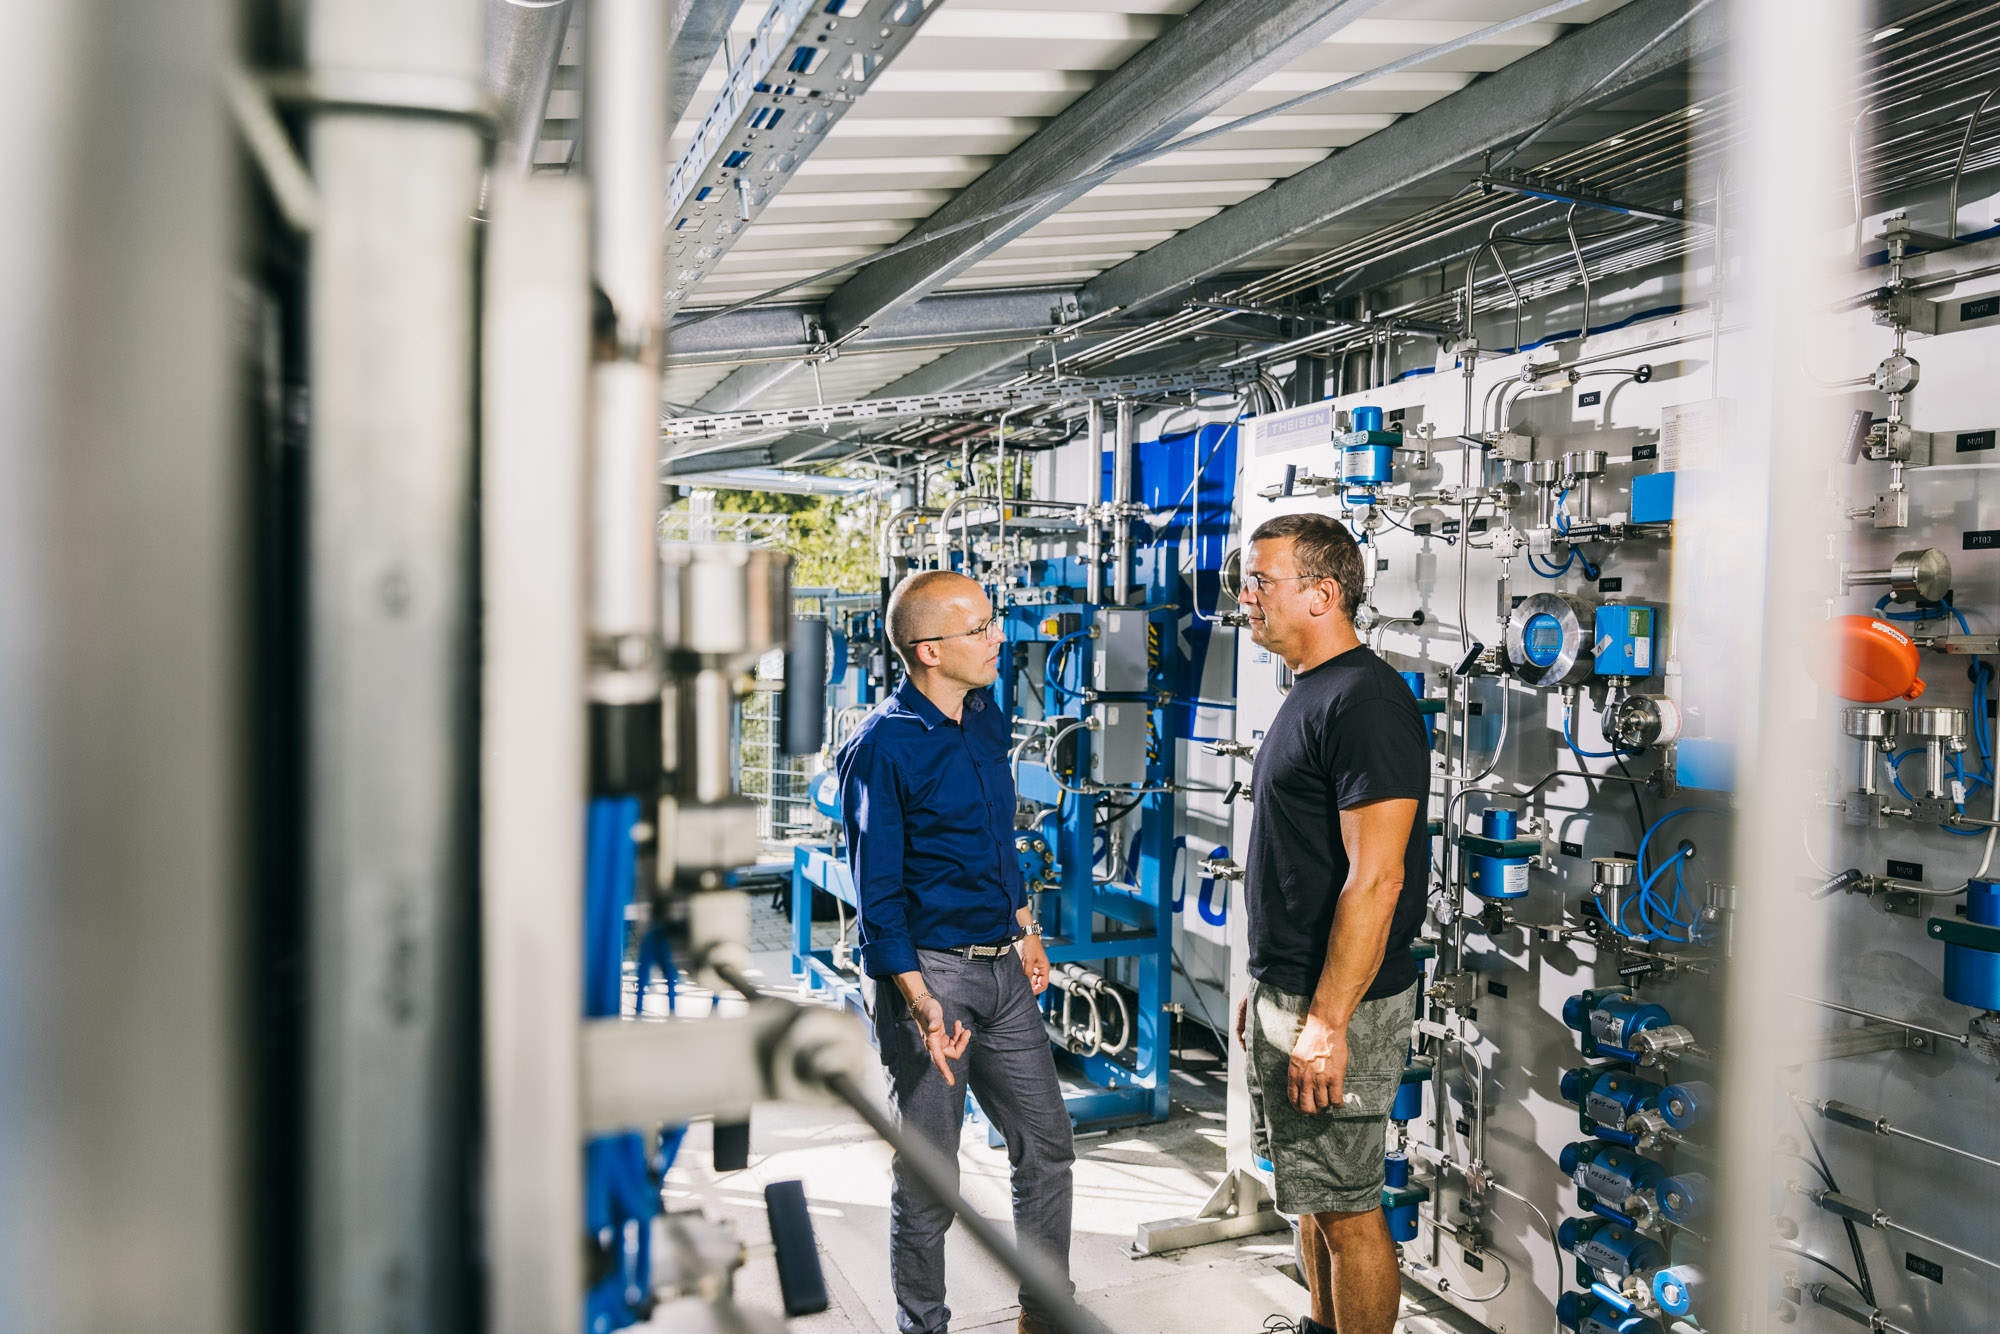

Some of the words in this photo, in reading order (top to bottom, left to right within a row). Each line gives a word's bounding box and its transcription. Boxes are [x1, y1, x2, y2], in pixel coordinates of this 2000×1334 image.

[1970, 303, 1989, 314] MV12
[1271, 414, 1325, 434] THEISEN
[1967, 436, 1984, 445] MV11
[1620, 964, 1651, 974] MAXIMATOR
